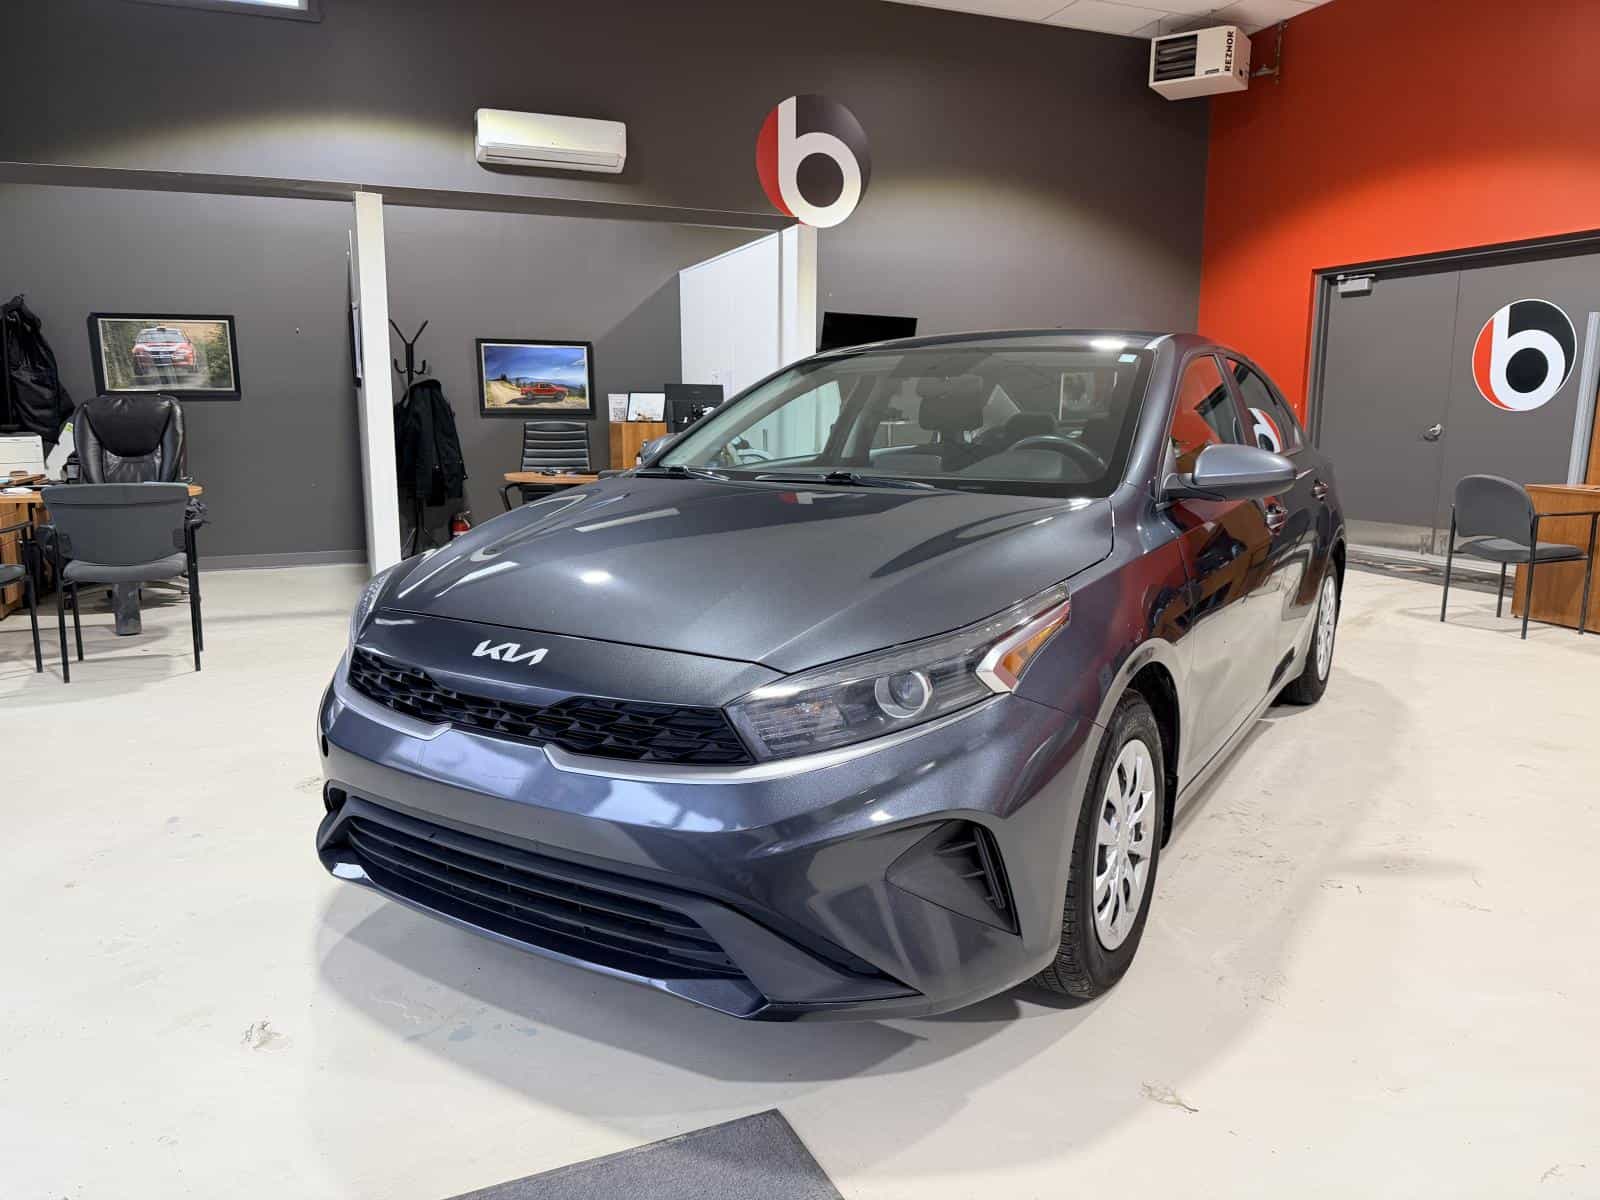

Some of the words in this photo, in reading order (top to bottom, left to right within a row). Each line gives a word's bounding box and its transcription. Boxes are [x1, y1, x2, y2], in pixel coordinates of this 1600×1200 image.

[1224, 31, 1234, 72] REZNOR
[778, 95, 862, 228] b
[1489, 303, 1566, 411] b
[471, 640, 549, 666] KIA
